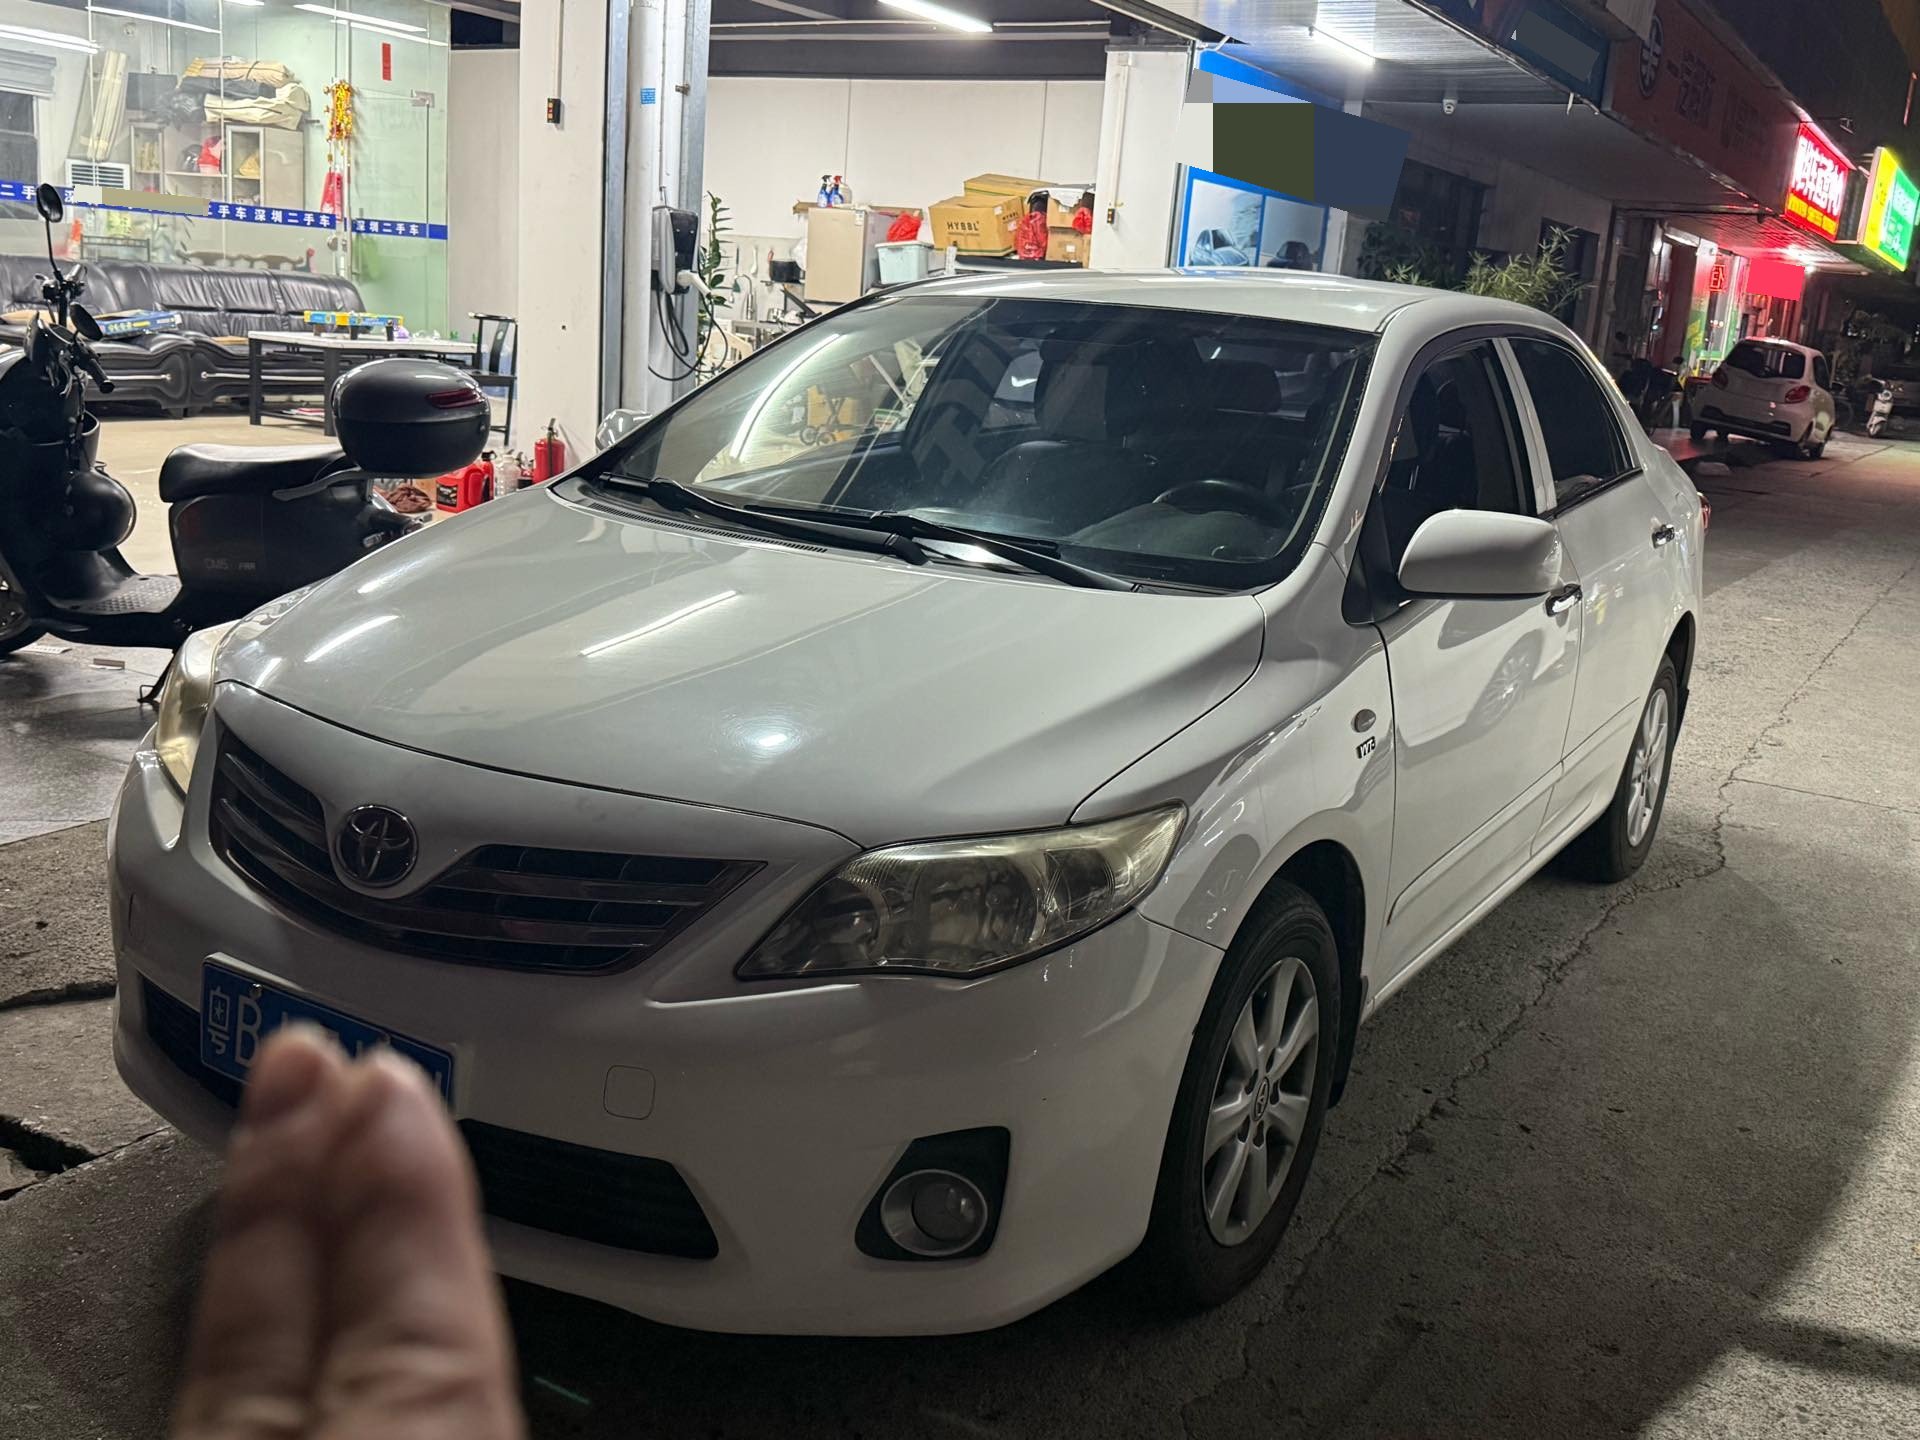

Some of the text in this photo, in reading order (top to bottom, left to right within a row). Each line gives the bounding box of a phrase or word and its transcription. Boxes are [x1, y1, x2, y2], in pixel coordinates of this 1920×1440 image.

[356, 220, 418, 236] 深圳二手车
[947, 222, 979, 231] HYBBL
